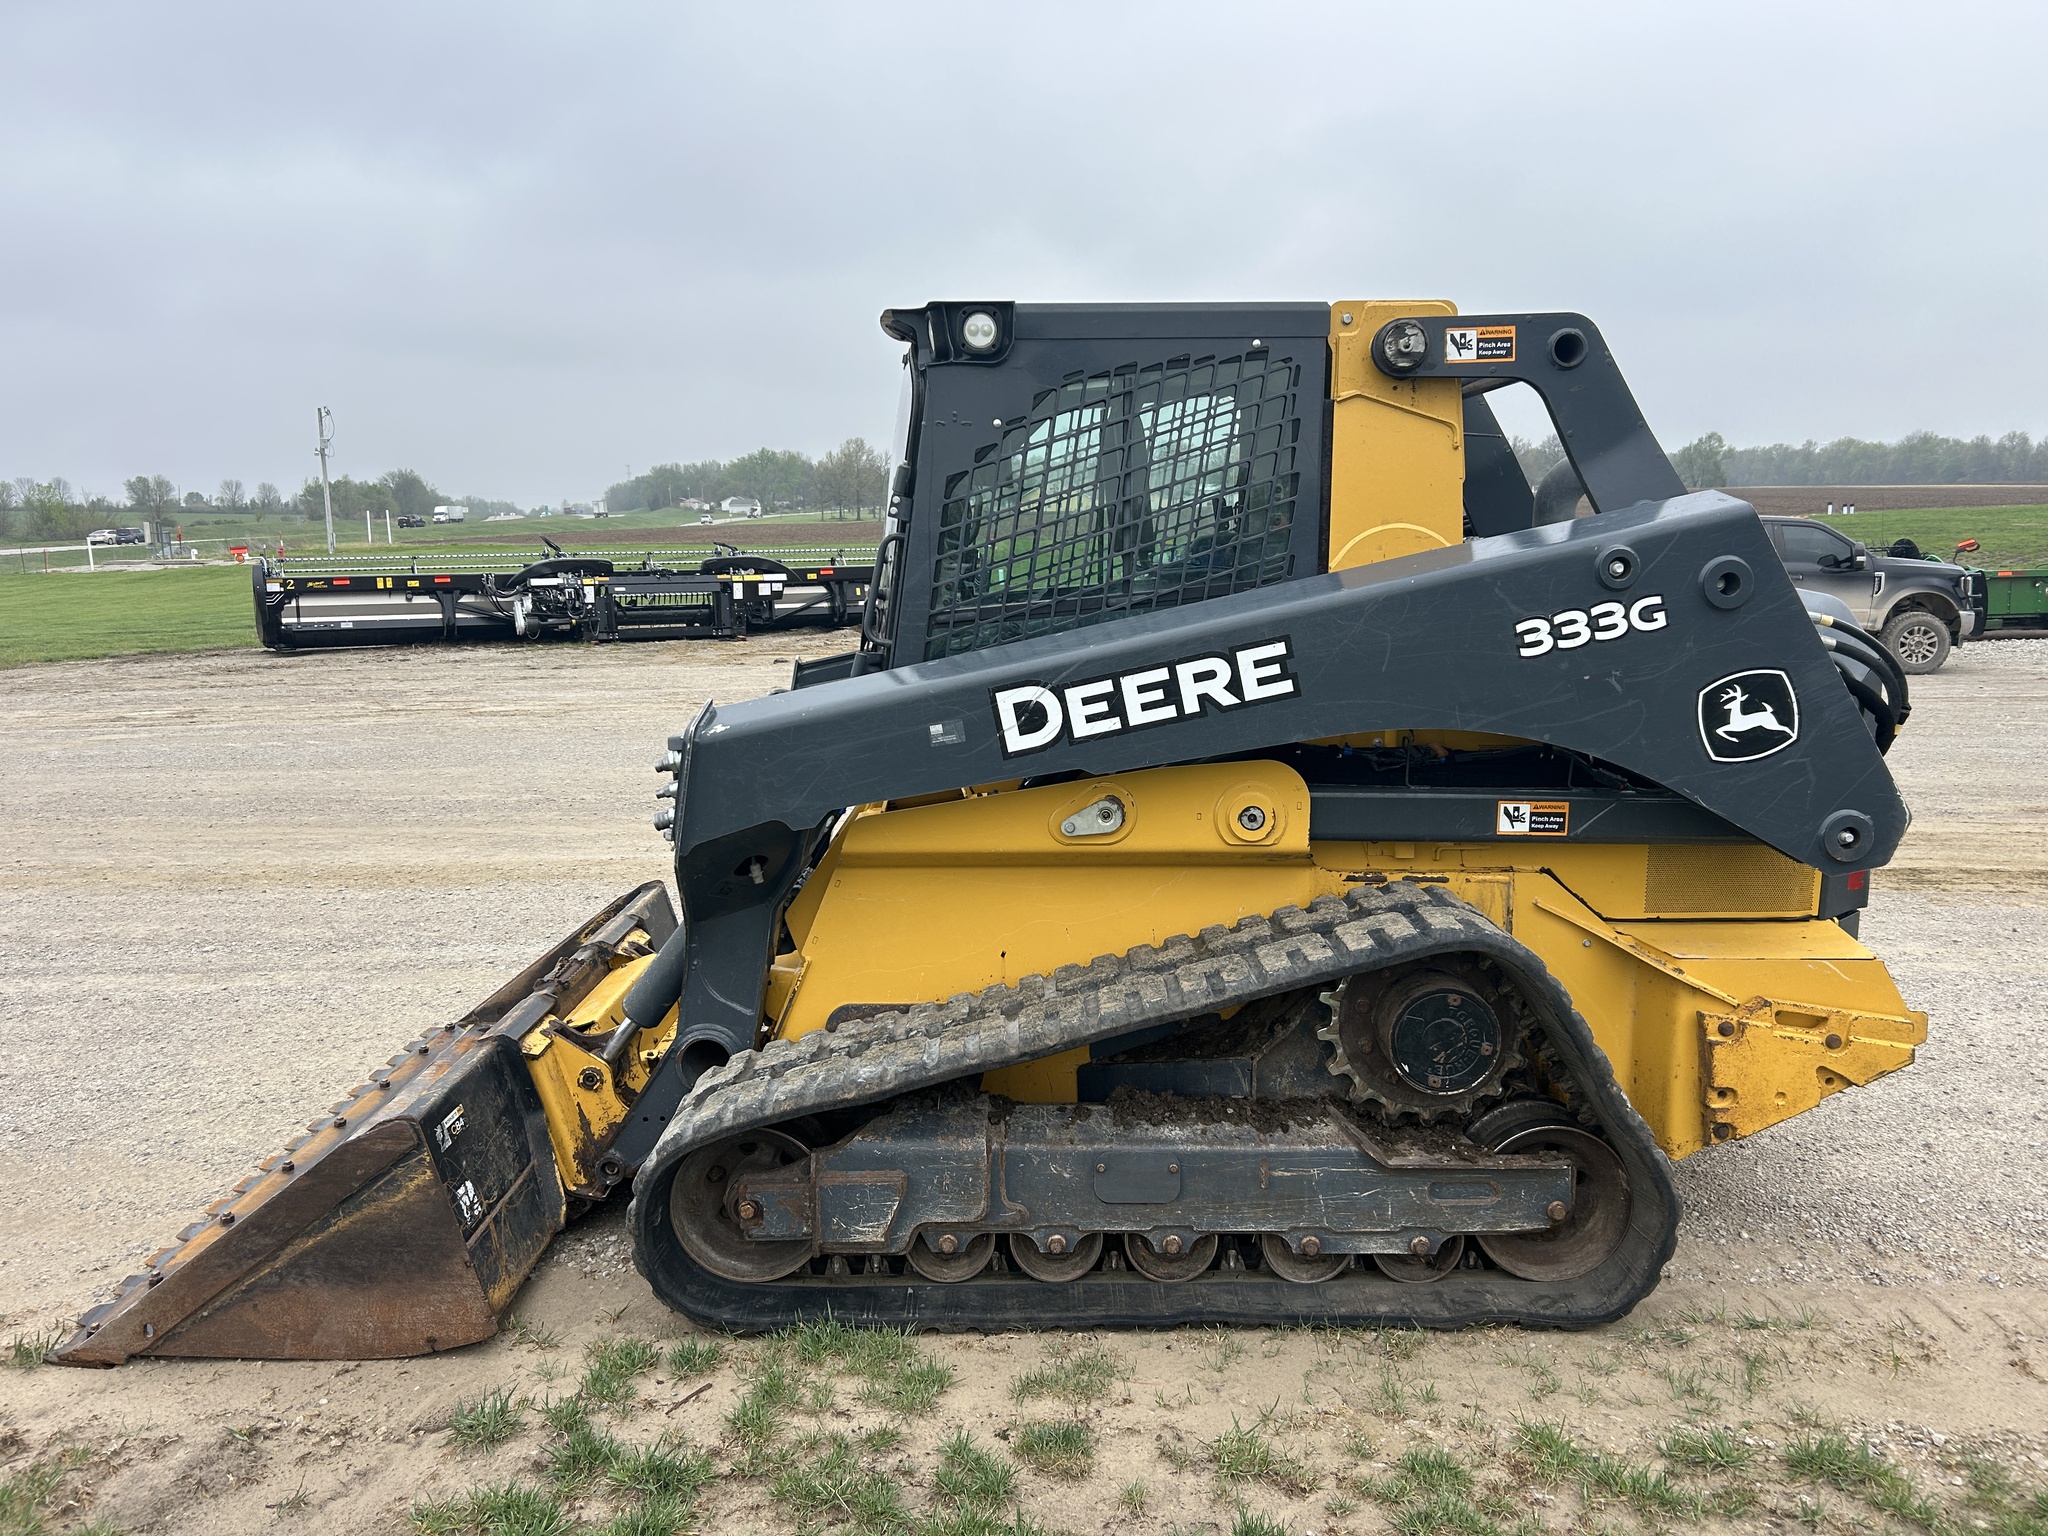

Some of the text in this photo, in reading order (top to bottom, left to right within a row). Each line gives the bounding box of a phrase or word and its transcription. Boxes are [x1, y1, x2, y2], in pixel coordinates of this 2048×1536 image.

[286, 579, 295, 590] 2
[1515, 595, 1668, 657] 333G
[995, 641, 1294, 753] DEERE
